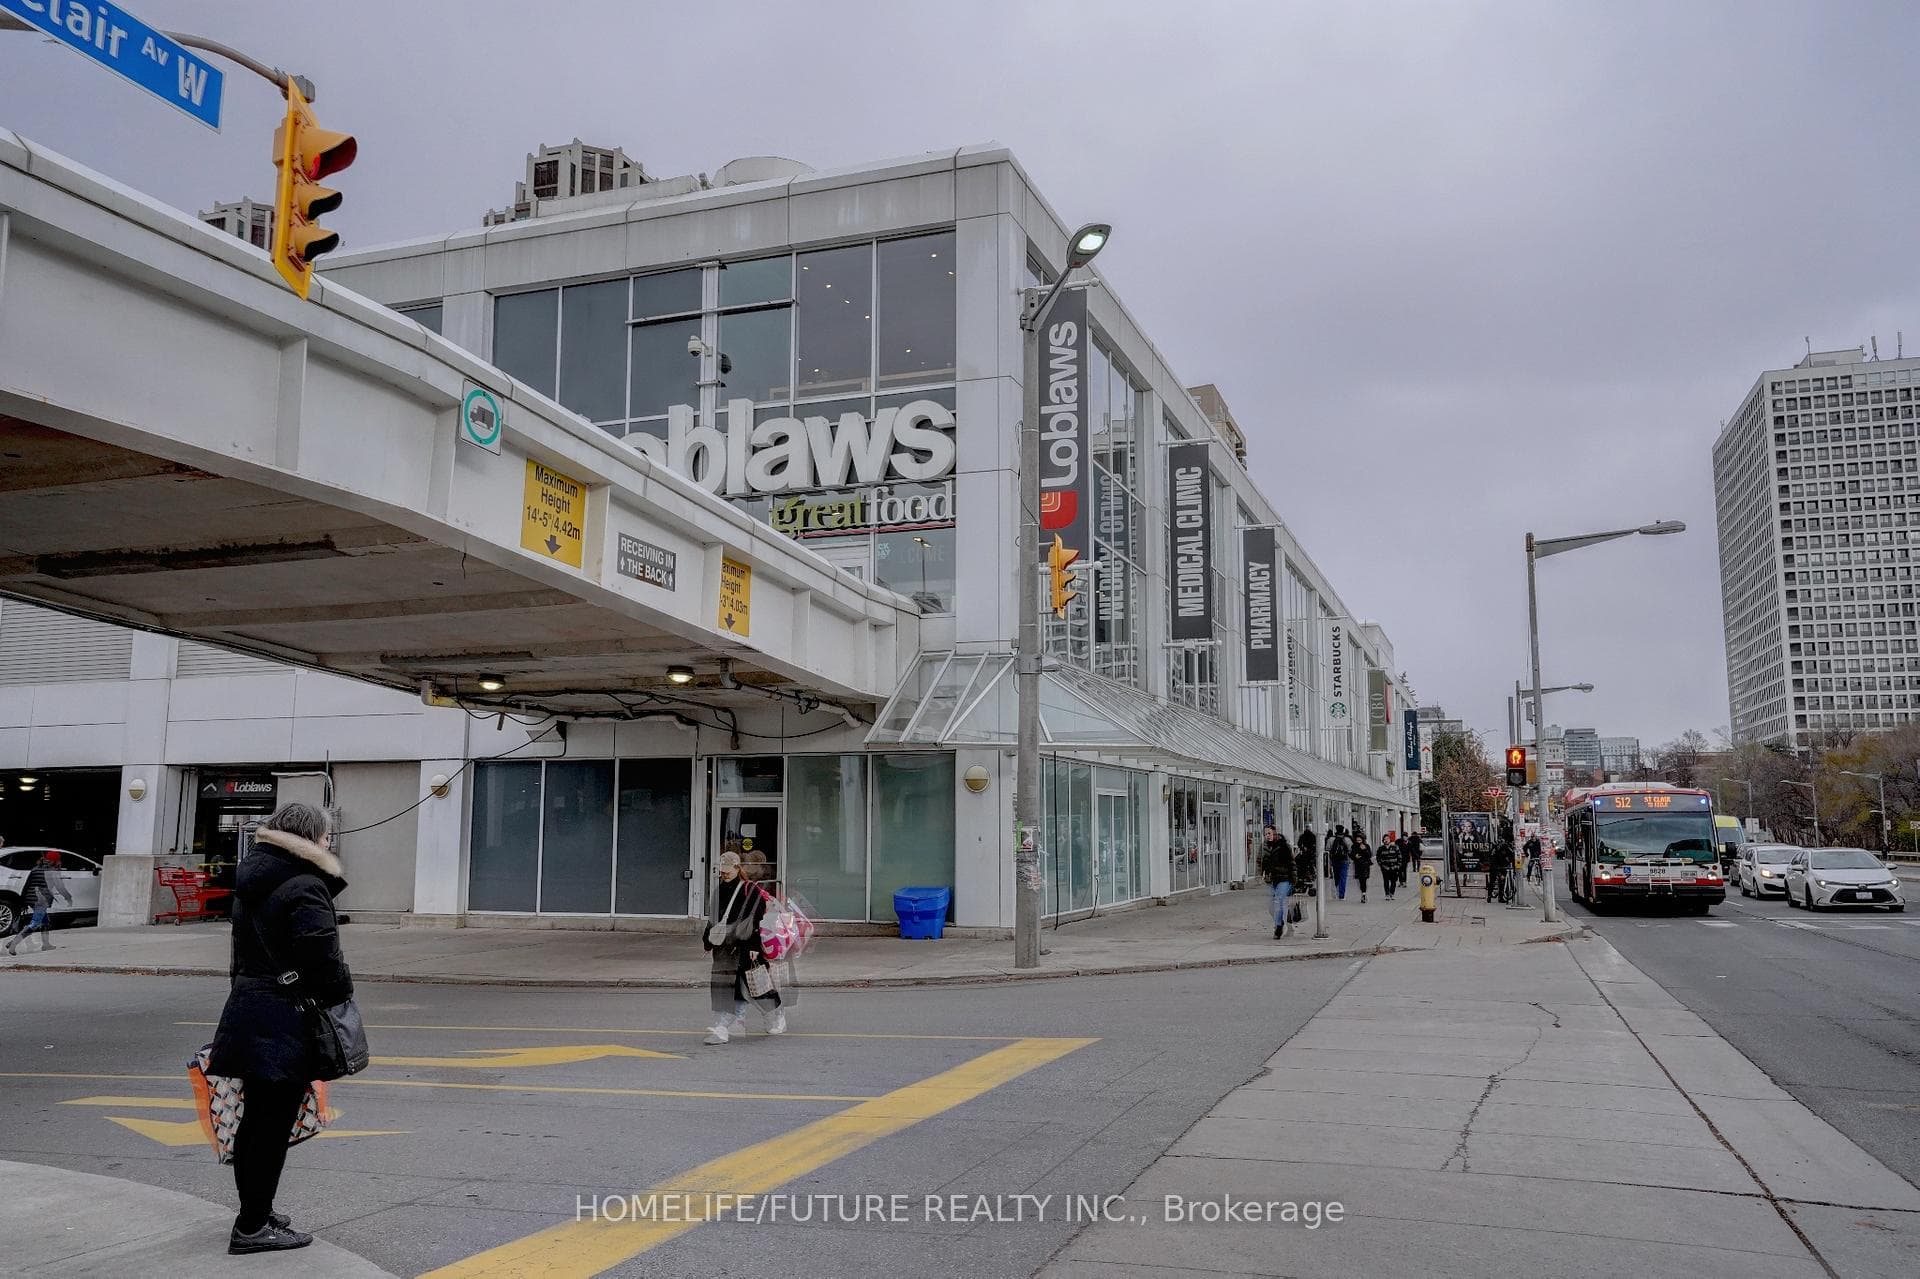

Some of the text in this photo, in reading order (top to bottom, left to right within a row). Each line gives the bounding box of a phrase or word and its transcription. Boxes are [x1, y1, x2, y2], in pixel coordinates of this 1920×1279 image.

[22, 0, 208, 107] lair Av W
[1040, 320, 1079, 488] Loblaws
[535, 465, 578, 498] Maximum
[541, 487, 571, 514] Height
[772, 484, 956, 539] great food
[620, 536, 674, 569] RECEIVING IN
[1175, 466, 1204, 617] MEDICAL CLINIC
[627, 558, 667, 585] THE BACK
[722, 562, 746, 579] aximum
[1248, 561, 1273, 650] PHARMACY
[1332, 625, 1343, 698] STARBUCKS
[234, 781, 273, 793] Loblaws
[1615, 796, 1631, 809] 512
